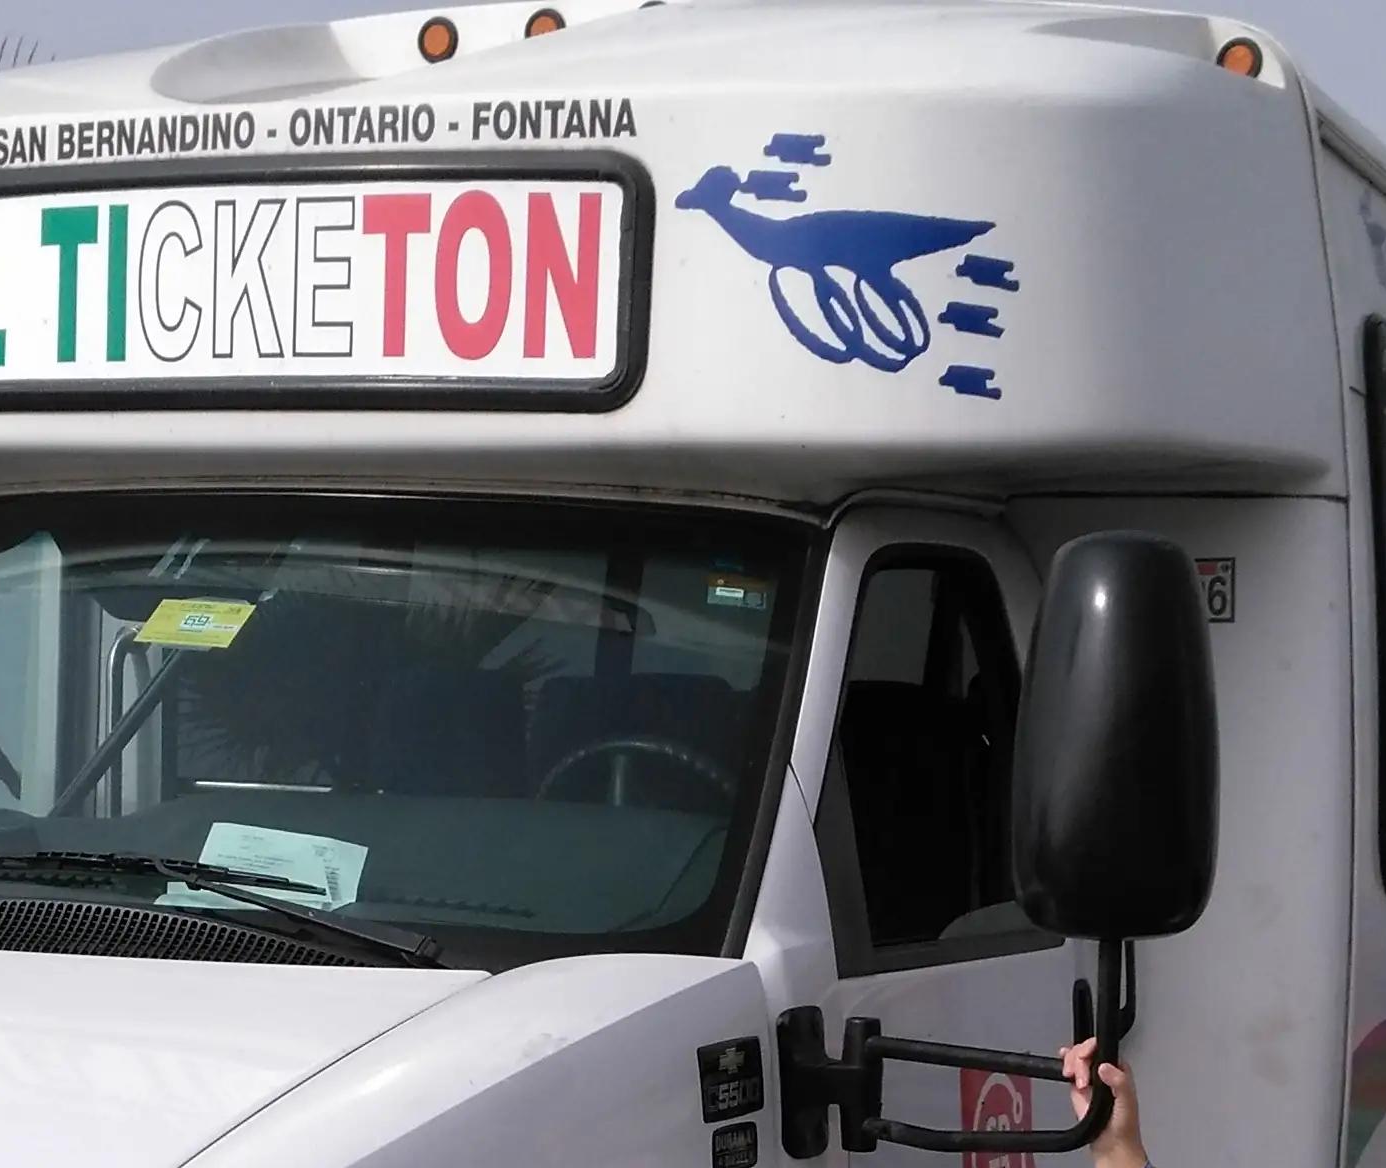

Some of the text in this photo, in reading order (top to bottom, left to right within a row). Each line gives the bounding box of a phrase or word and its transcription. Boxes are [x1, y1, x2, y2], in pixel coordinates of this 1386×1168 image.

[58, 111, 255, 161] BERNANDINO
[289, 106, 437, 147] ONTARIO
[471, 98, 637, 140] FONTANA
[40, 189, 602, 364] TICKETON
